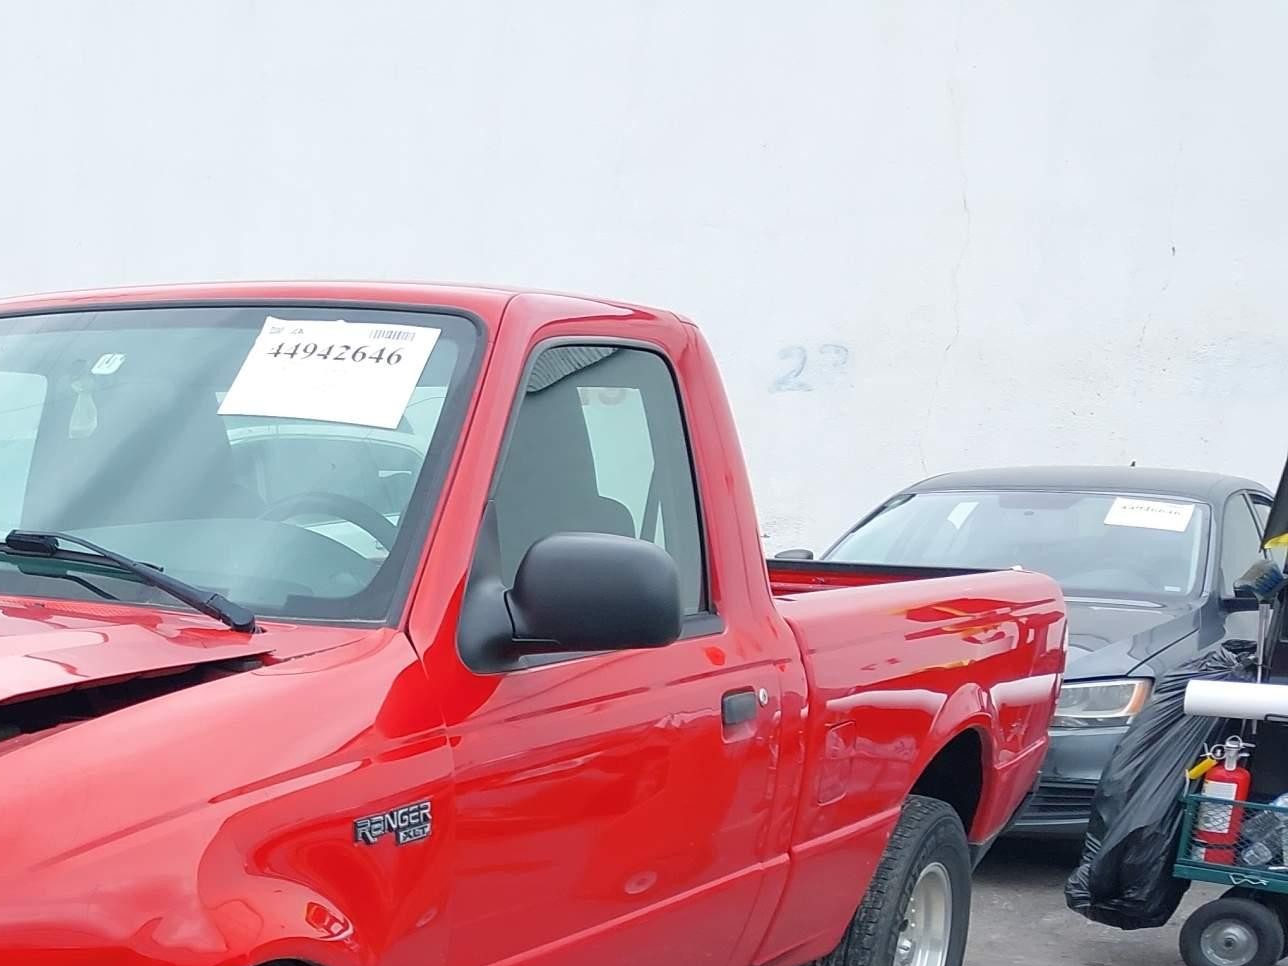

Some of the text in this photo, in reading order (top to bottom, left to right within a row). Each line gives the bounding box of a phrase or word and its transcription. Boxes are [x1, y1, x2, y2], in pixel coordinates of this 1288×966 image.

[266, 342, 405, 366] 44942646
[354, 800, 433, 844] RANGER
[398, 823, 432, 844] XLT
